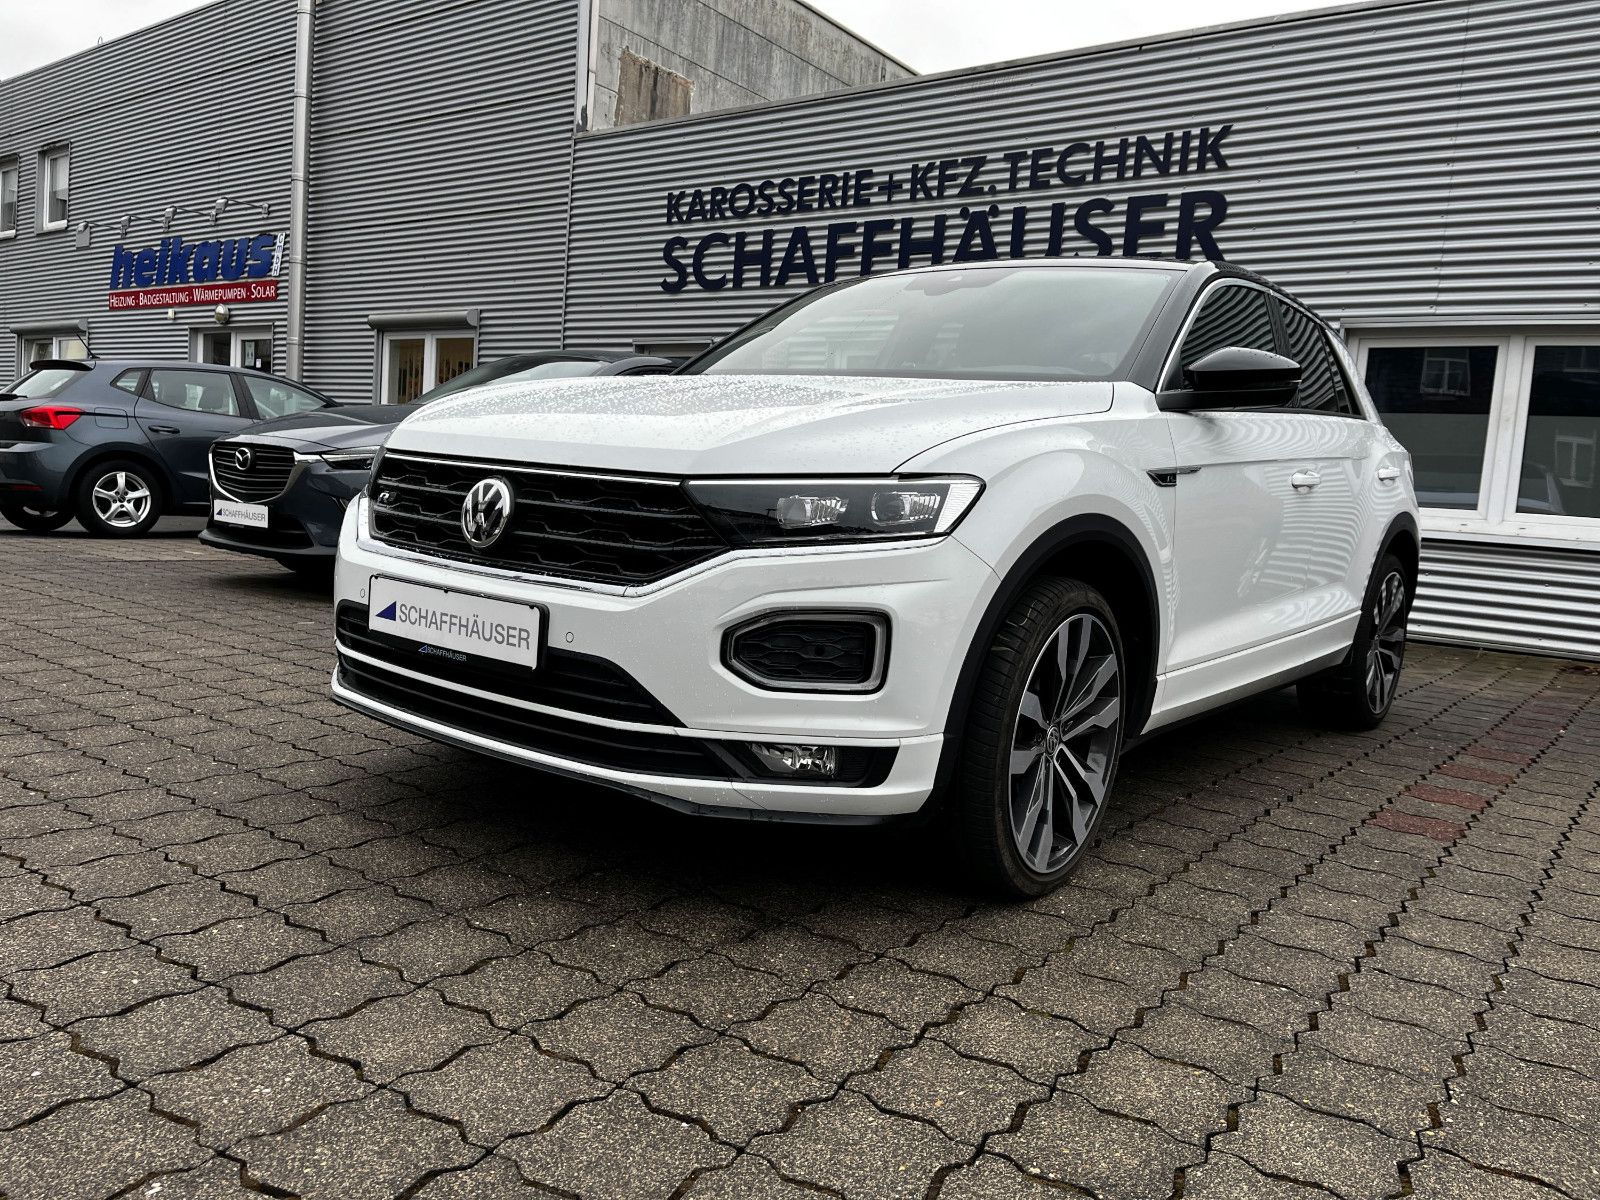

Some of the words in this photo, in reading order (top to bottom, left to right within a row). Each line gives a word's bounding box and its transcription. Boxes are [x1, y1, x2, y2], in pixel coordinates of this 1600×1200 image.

[109, 233, 276, 290] heikaus
[273, 233, 285, 277] GmbH
[660, 190, 1228, 293] SCHAFFHÄUSER
[222, 508, 266, 522] SCHAFFHÄUSER
[399, 603, 531, 651] SCHAFFHÄUSER
[427, 647, 467, 662] SCHAFFHÄUSER
